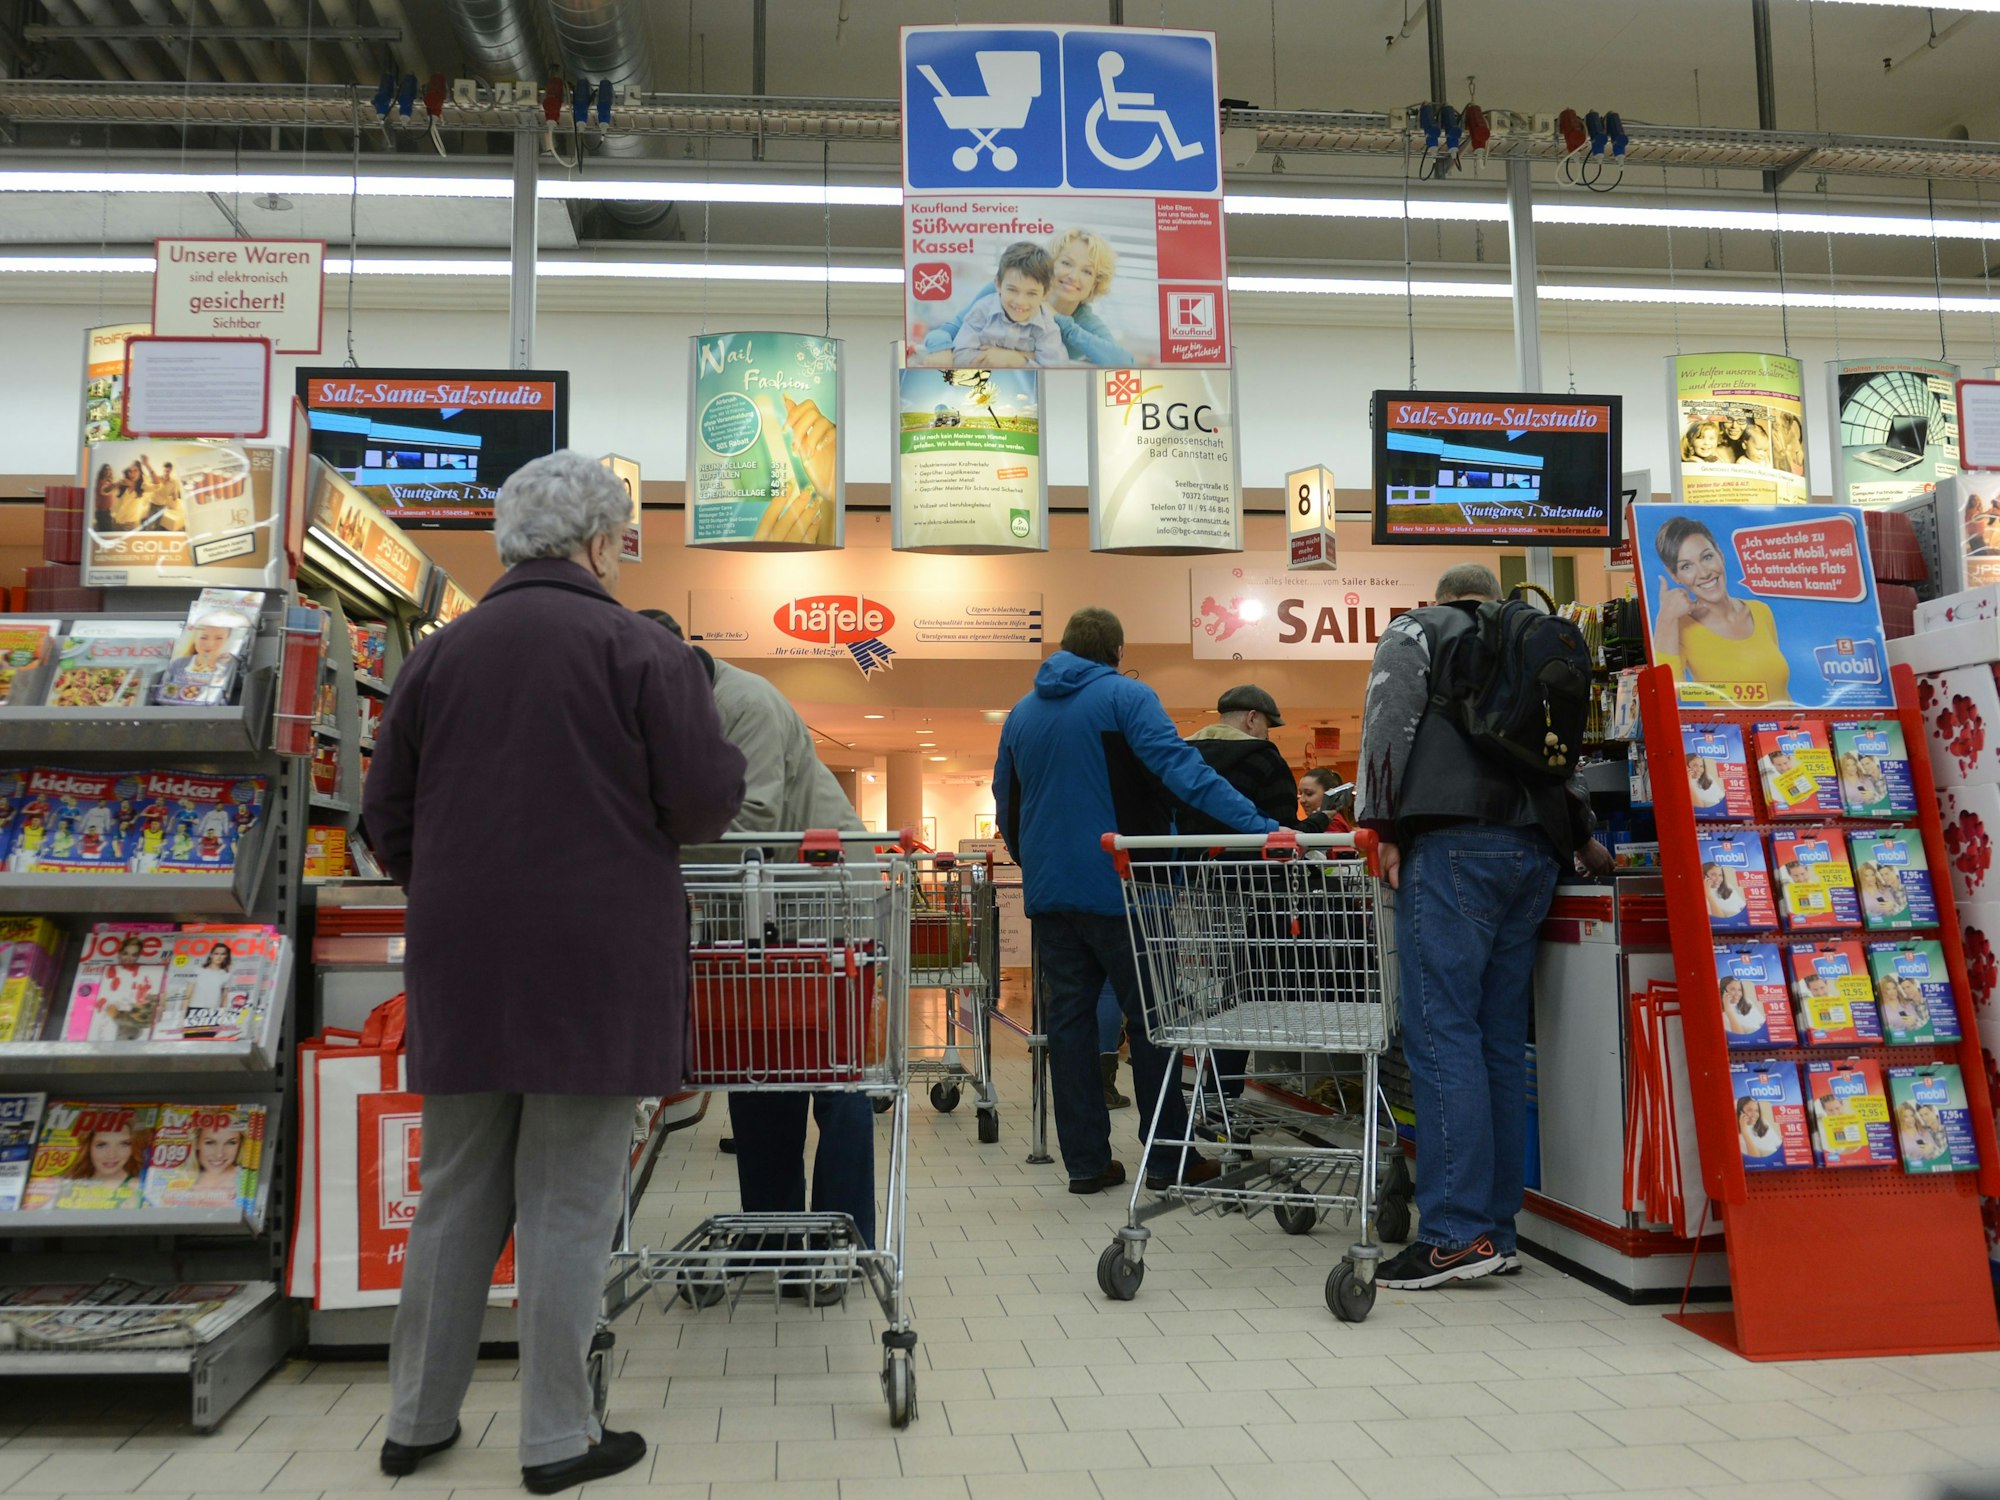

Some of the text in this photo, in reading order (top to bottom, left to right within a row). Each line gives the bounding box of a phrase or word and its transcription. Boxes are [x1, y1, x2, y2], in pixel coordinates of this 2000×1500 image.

[911, 203, 1020, 214] Kaufland Service:
[1174, 204, 1194, 212] Eltern,
[911, 217, 1055, 236] Süßwarenfreie
[1171, 218, 1213, 226] süßwarenfreie
[911, 238, 975, 255] Kasse!
[169, 245, 311, 265] Unsere Waren
[189, 271, 288, 283] sind elektronisch
[189, 290, 285, 314] gesichert!
[212, 317, 261, 329] Sichtbar
[1172, 327, 1213, 337] Kaufland
[1172, 343, 1203, 355] Hier bin
[1181, 345, 1221, 360] ich richtig!
[700, 339, 754, 380] Nail
[1679, 366, 1757, 380] Wir helfen unseren
[743, 368, 811, 391] Fashion
[1708, 378, 1757, 390] deren Eltern
[319, 382, 543, 406] Salz-Sana-Salzstudio
[1396, 404, 1598, 428] Salz-Sana-Salzstudio
[1137, 435, 1225, 449] Baugenossenschaft
[1149, 448, 1229, 462] Bad Cannstatt eG
[699, 462, 758, 472] NEUMODELLAGE
[1175, 480, 1222, 491] Seelbergstraße
[393, 486, 459, 502] Stuttgarts
[463, 487, 474, 500] 1.
[1182, 491, 1230, 504] 70372 Stuttgart
[1298, 484, 1312, 516] 8
[1151, 503, 1176, 511] Telefon
[1199, 504, 1208, 512] 95
[1326, 488, 1332, 521] 8
[1464, 504, 1603, 519] Stuttgarts 1. Salzstudio
[1159, 515, 1231, 526] www.bgc-cannstatt.de
[1156, 526, 1231, 538] info@bgc-cannstatt.de
[1291, 536, 1321, 548] Bitte nicht
[1764, 531, 1809, 546] wechsle
[1810, 531, 1826, 543] zu
[131, 540, 184, 554] GOLD
[1297, 546, 1314, 555] mehr
[1742, 543, 1854, 562] K-Classic Mobil, weil
[1745, 561, 1847, 575] ich attraktive Flats
[1342, 577, 1367, 586] Sailer
[1750, 576, 1803, 590] zubuchen
[787, 594, 886, 649] häfele
[1823, 658, 1876, 675] mobil
[1733, 684, 1766, 701] 9.95
[1697, 743, 1727, 756] mobil
[1857, 740, 1888, 752] mobil
[1723, 763, 1730, 772] 9
[30, 772, 108, 795] kicker
[149, 775, 223, 799] kicker
[1729, 779, 1739, 788] 10
[1715, 851, 1745, 863] mobil
[1800, 851, 1829, 862] mobil
[1877, 850, 1907, 862] mobil
[1742, 871, 1750, 880] 9
[1750, 887, 1760, 896] 10
[1733, 965, 1764, 978] mobil
[1818, 964, 1849, 976] mobil
[1897, 963, 1928, 975] mobil
[1762, 985, 1769, 994] 9
[1769, 1002, 1780, 1011] 10
[1751, 1085, 1782, 1098] mobil
[1834, 1084, 1864, 1096] mobil
[1916, 1089, 1947, 1101] mobil
[1779, 1106, 1786, 1115] 9
[70, 1109, 136, 1137] pur
[190, 1107, 232, 1132] top
[1786, 1124, 1796, 1132] 10
